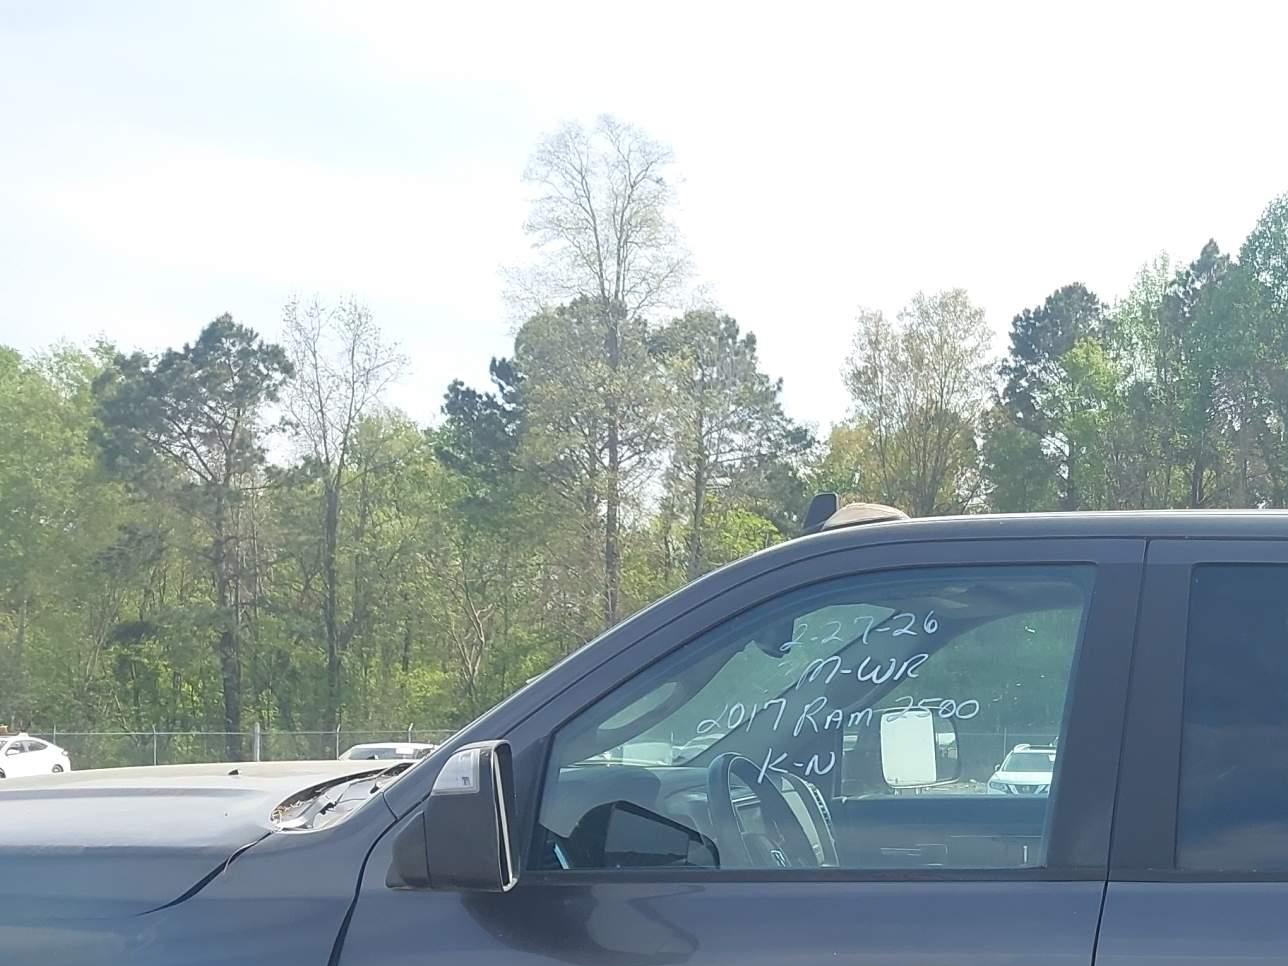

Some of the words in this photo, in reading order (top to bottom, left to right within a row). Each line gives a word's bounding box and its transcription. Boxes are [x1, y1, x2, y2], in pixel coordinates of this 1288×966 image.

[780, 610, 938, 652] 2-27-26
[696, 698, 787, 733] 2017
[886, 695, 980, 723] 2500
[757, 747, 837, 784] K-N
